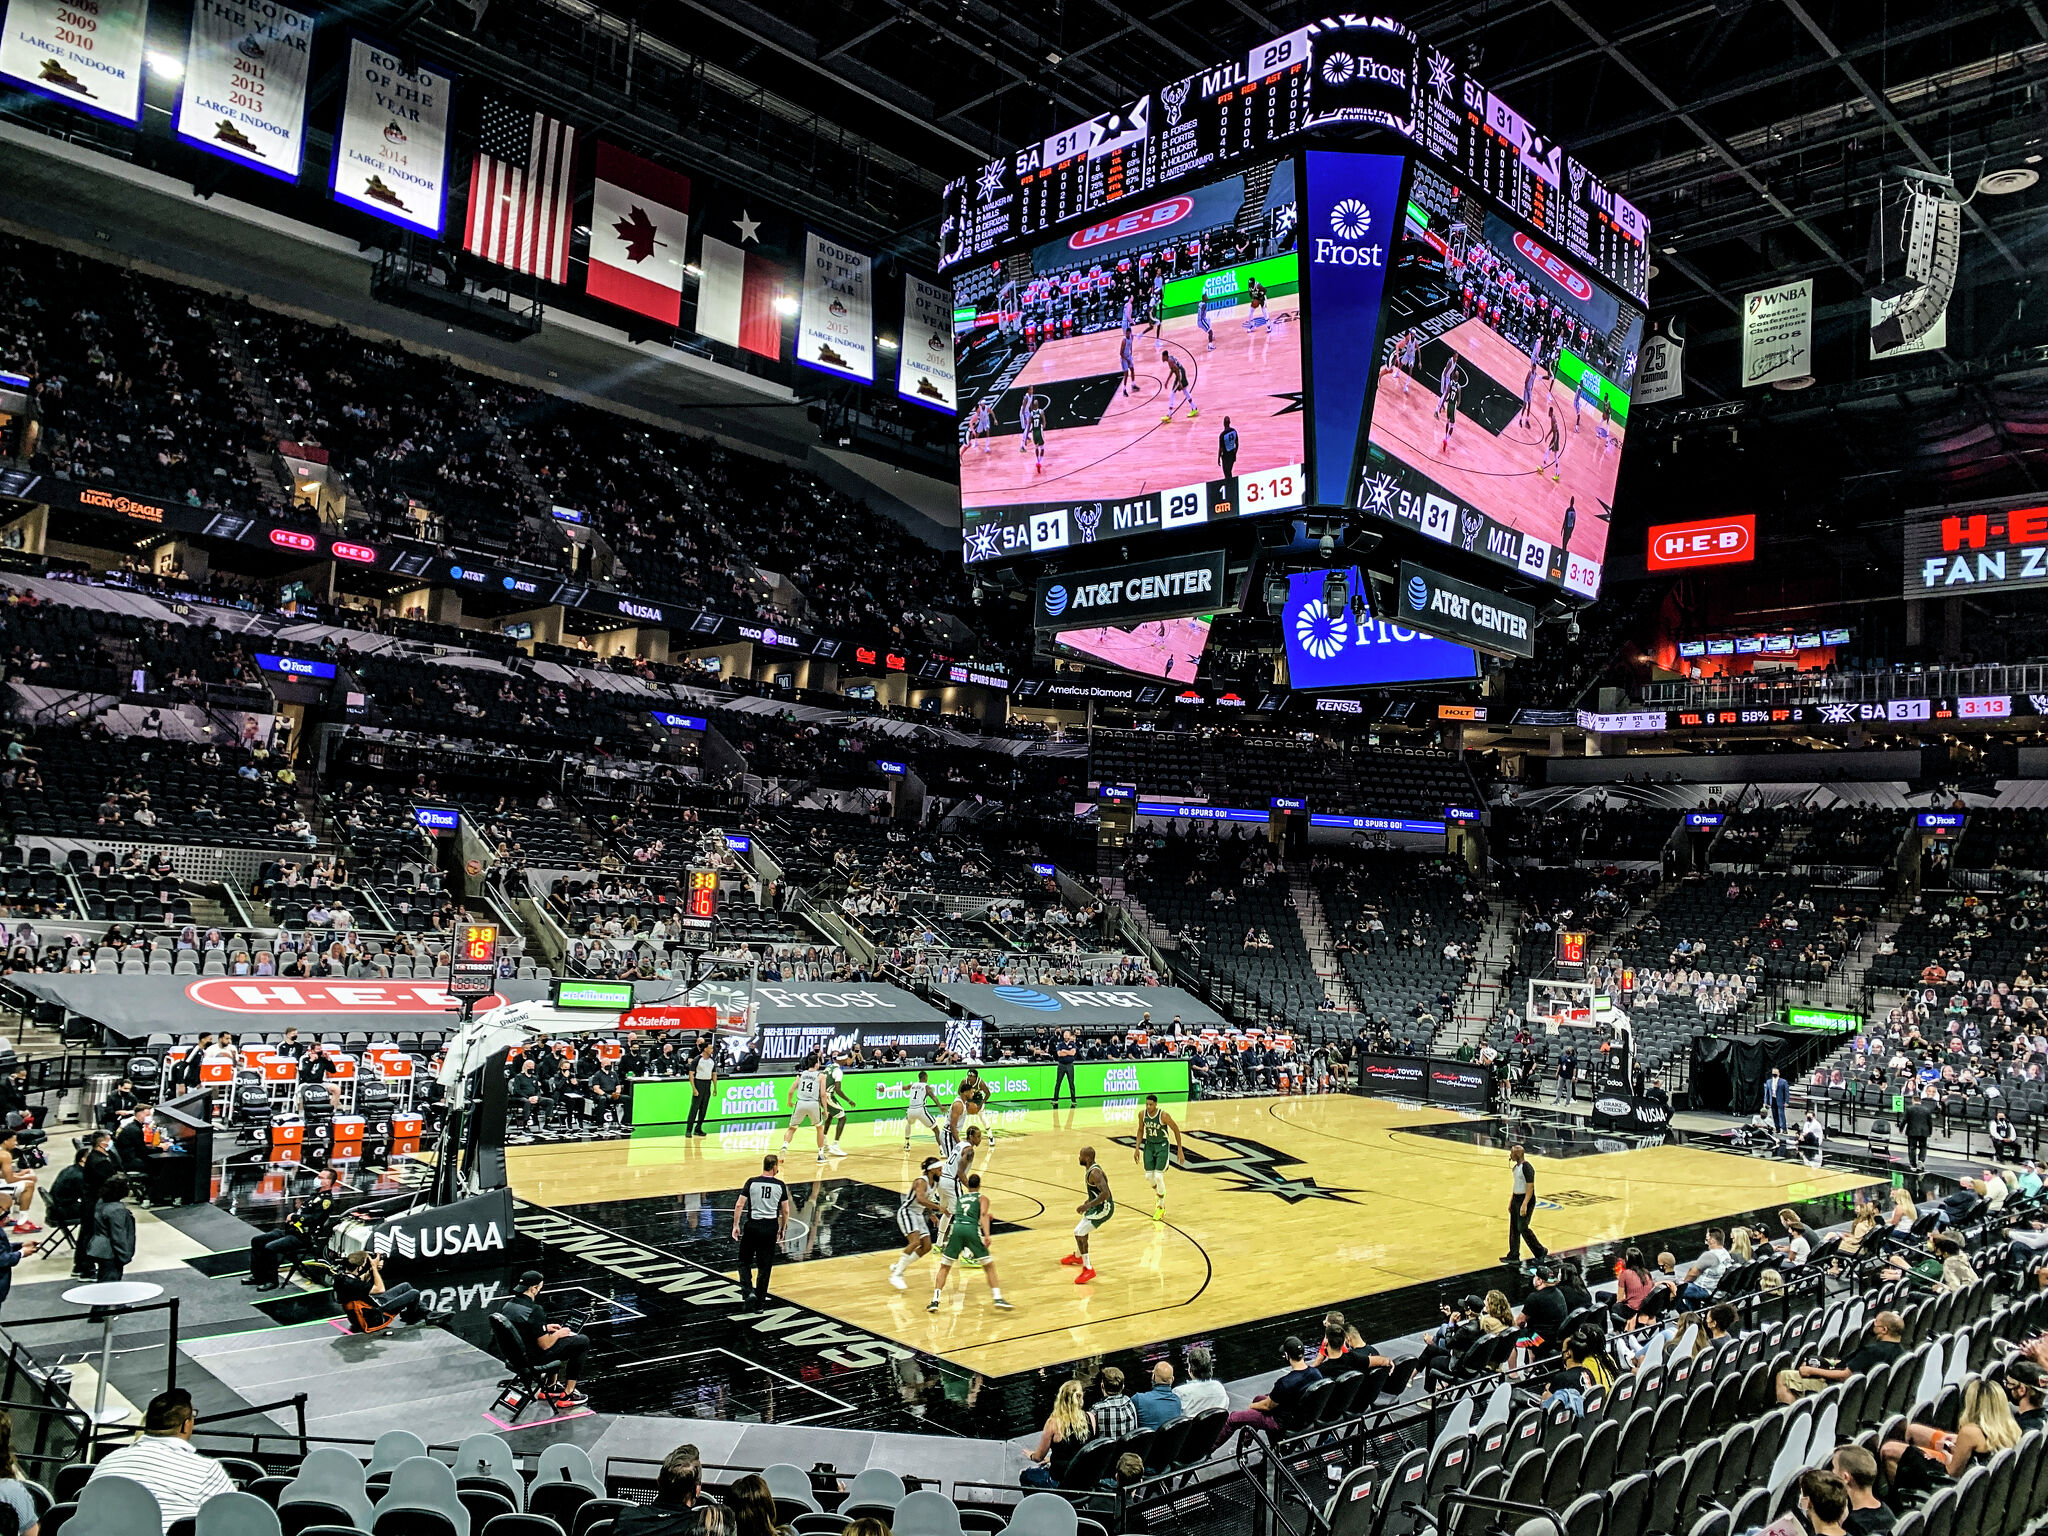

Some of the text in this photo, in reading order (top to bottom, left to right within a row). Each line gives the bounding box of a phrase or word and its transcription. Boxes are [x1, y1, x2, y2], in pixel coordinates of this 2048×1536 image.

[56, 9, 97, 33] 2009
[200, 0, 308, 53] THE YEAR
[54, 27, 94, 52] 2010
[19, 32, 126, 79] LARGE INDOOR
[233, 57, 266, 80] 2011
[1201, 40, 1292, 98] MIL 29
[1357, 56, 1406, 89] Frost
[231, 74, 266, 97] 2012
[366, 69, 433, 107] OF THE
[1217, 63, 1302, 105] PTS AST PF
[229, 91, 264, 114] 2013
[376, 93, 420, 123] YEAR
[195, 96, 290, 139] LARGE INDOOR
[1170, 119, 1198, 138] FORBES
[1170, 131, 1195, 147] PORTIS
[379, 145, 408, 167] 2014
[1016, 130, 1078, 175] SA 31
[1169, 140, 1197, 158] TUCKER
[1463, 80, 1484, 116] SA
[1496, 105, 1513, 135] 31
[1590, 180, 1614, 216] MIL
[1622, 205, 1636, 229] 29
[1167, 149, 1198, 168] HOLIDAY
[349, 150, 434, 191] LARGE INDOOR
[982, 209, 1000, 222] MILLS
[1082, 203, 1179, 243] H-E-B
[819, 242, 861, 267] RODEO
[1314, 237, 1382, 267] Frost
[1522, 238, 1586, 294] H-E-B
[1763, 286, 1807, 307] WNBA
[1749, 312, 1807, 330] Conference
[1757, 307, 1799, 320] Western
[827, 320, 849, 335] 2015
[1749, 319, 1806, 336] Champions
[809, 329, 866, 352] LARGE INDOOR
[1753, 330, 1802, 347] 2008
[907, 359, 931, 373] LARGE
[927, 353, 946, 367] 2016
[1643, 342, 1667, 374] 25
[80, 491, 115, 509] LUCKY
[130, 501, 165, 519] EAGLE
[1003, 476, 1294, 549] SA 31 MIL 29 1 QTR 3:13
[276, 532, 310, 548] H-E-B
[1397, 490, 1595, 588] SA 31 MIL 29 3:13
[1665, 530, 1739, 556] H-E-B
[338, 545, 370, 560] H-E-B
[463, 569, 486, 583] AT&T
[1921, 550, 2007, 589] FAN
[515, 580, 537, 593] AT&T
[1071, 567, 1212, 609] AT&T CENTER
[172, 605, 189, 615] 106
[632, 605, 662, 621] USAA
[1430, 587, 1528, 641] AT&T CENTER
[738, 626, 799, 648] TACO BELL
[434, 648, 447, 656] 107
[290, 661, 313, 674] Frost
[969, 673, 1008, 690] SPURS RADIO
[1048, 684, 1134, 700] Americus Diamond
[1444, 708, 1472, 718] HOLT
[1679, 709, 1803, 725] TOL 6 FG 58% PF 2
[1860, 704, 1887, 720] SA
[1895, 703, 1923, 719] 31
[1964, 700, 2004, 714] 3:13
[675, 716, 691, 728] Frost
[431, 814, 454, 826] Frost
[1179, 808, 1227, 818] GO SPURS GO!
[1701, 816, 1717, 824] Frost
[1936, 817, 1956, 825] Frost
[1353, 820, 1402, 829] GO SPURS GO!
[729, 839, 747, 850] Frost
[696, 889, 711, 915] 16
[470, 941, 485, 959] 16
[1566, 945, 1581, 961] 16
[755, 986, 897, 1009] Frost
[1056, 990, 1154, 1009] AT&T
[785, 1027, 801, 1036] TICKET
[802, 1026, 836, 1036] MEMBERSHIPS
[827, 1028, 860, 1055] NOW!
[1105, 1064, 1137, 1080] credit
[1397, 1068, 1424, 1080] TOYOTA
[242, 1077, 261, 1088] Frost
[727, 1080, 776, 1099] credit
[801, 1081, 814, 1093] 14
[1458, 1075, 1483, 1088] TOYOTA
[1606, 1079, 1624, 1087] odoo
[371, 1087, 388, 1097] Frost
[1645, 1107, 1666, 1122] USAA
[1148, 1128, 1158, 1138] 34
[761, 1185, 772, 1199] 18
[420, 1220, 504, 1258] USAA
[728, 1305, 930, 1376] SAN
